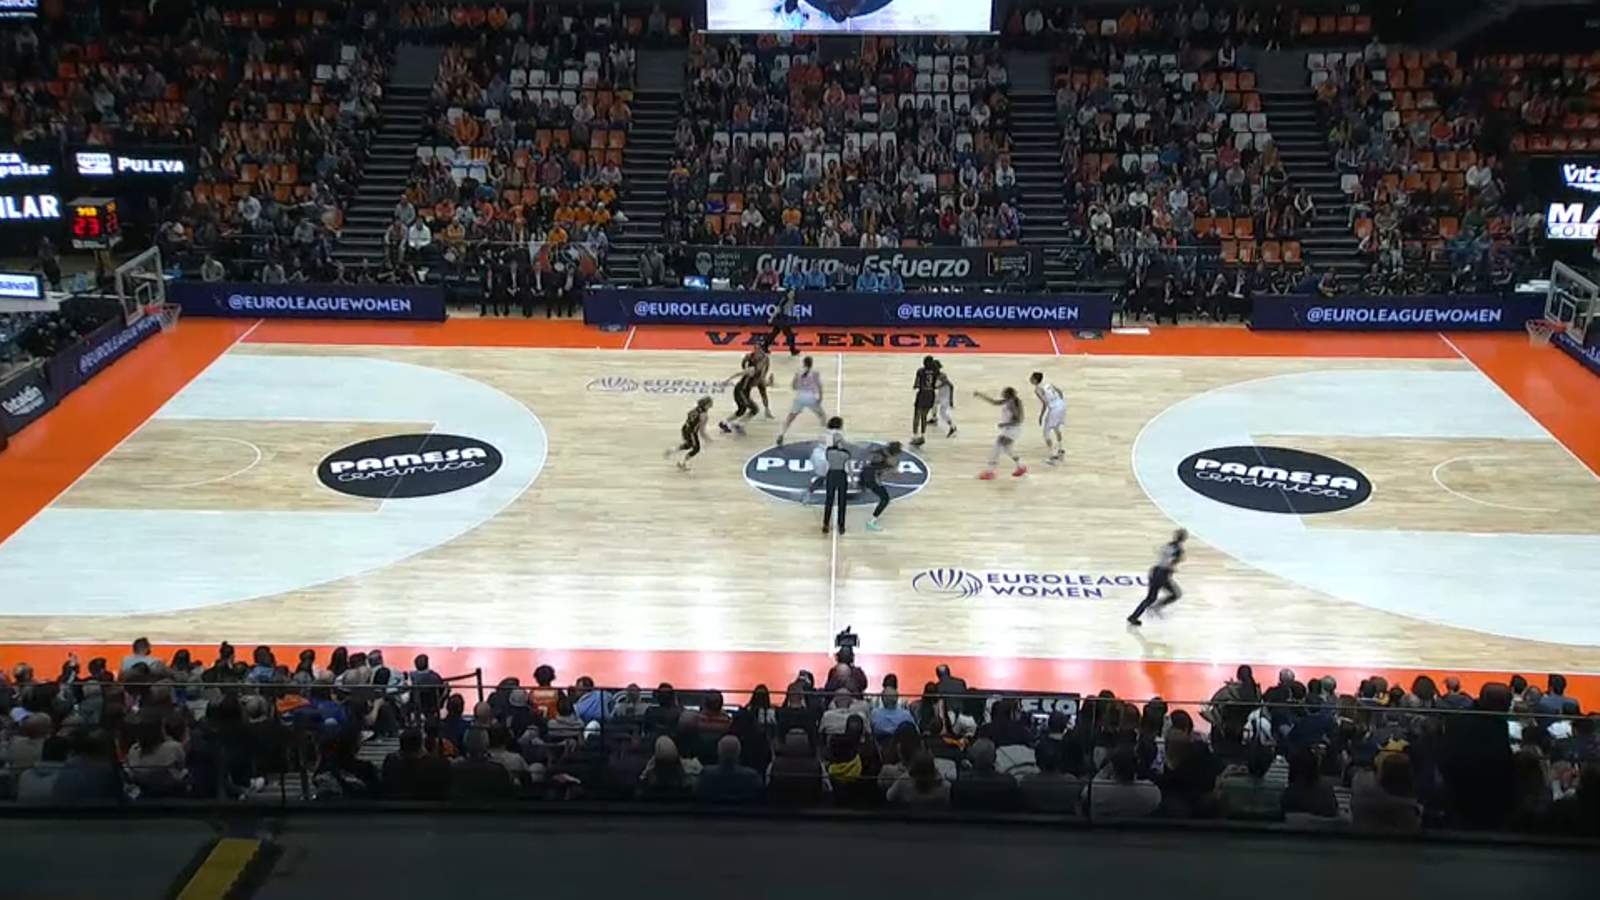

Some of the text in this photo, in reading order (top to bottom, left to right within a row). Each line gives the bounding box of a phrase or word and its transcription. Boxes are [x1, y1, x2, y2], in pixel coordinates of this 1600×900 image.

[117, 156, 185, 173] PULEVA
[863, 253, 971, 278] Esfuerzo
[229, 294, 412, 312] @EUROLEAGUEWOMEN
[634, 301, 812, 317] @EUROLEAGUEWOEN
[897, 304, 1079, 320] @EUROLEAGUEWOMEN
[1306, 307, 1503, 323] @EUROLEAGUEWOMEN
[330, 447, 488, 474] PAMESA
[1194, 458, 1358, 491] PAMESA
[988, 573, 1150, 586] EUROLEAGU
[990, 586, 1103, 598] WOMEN
